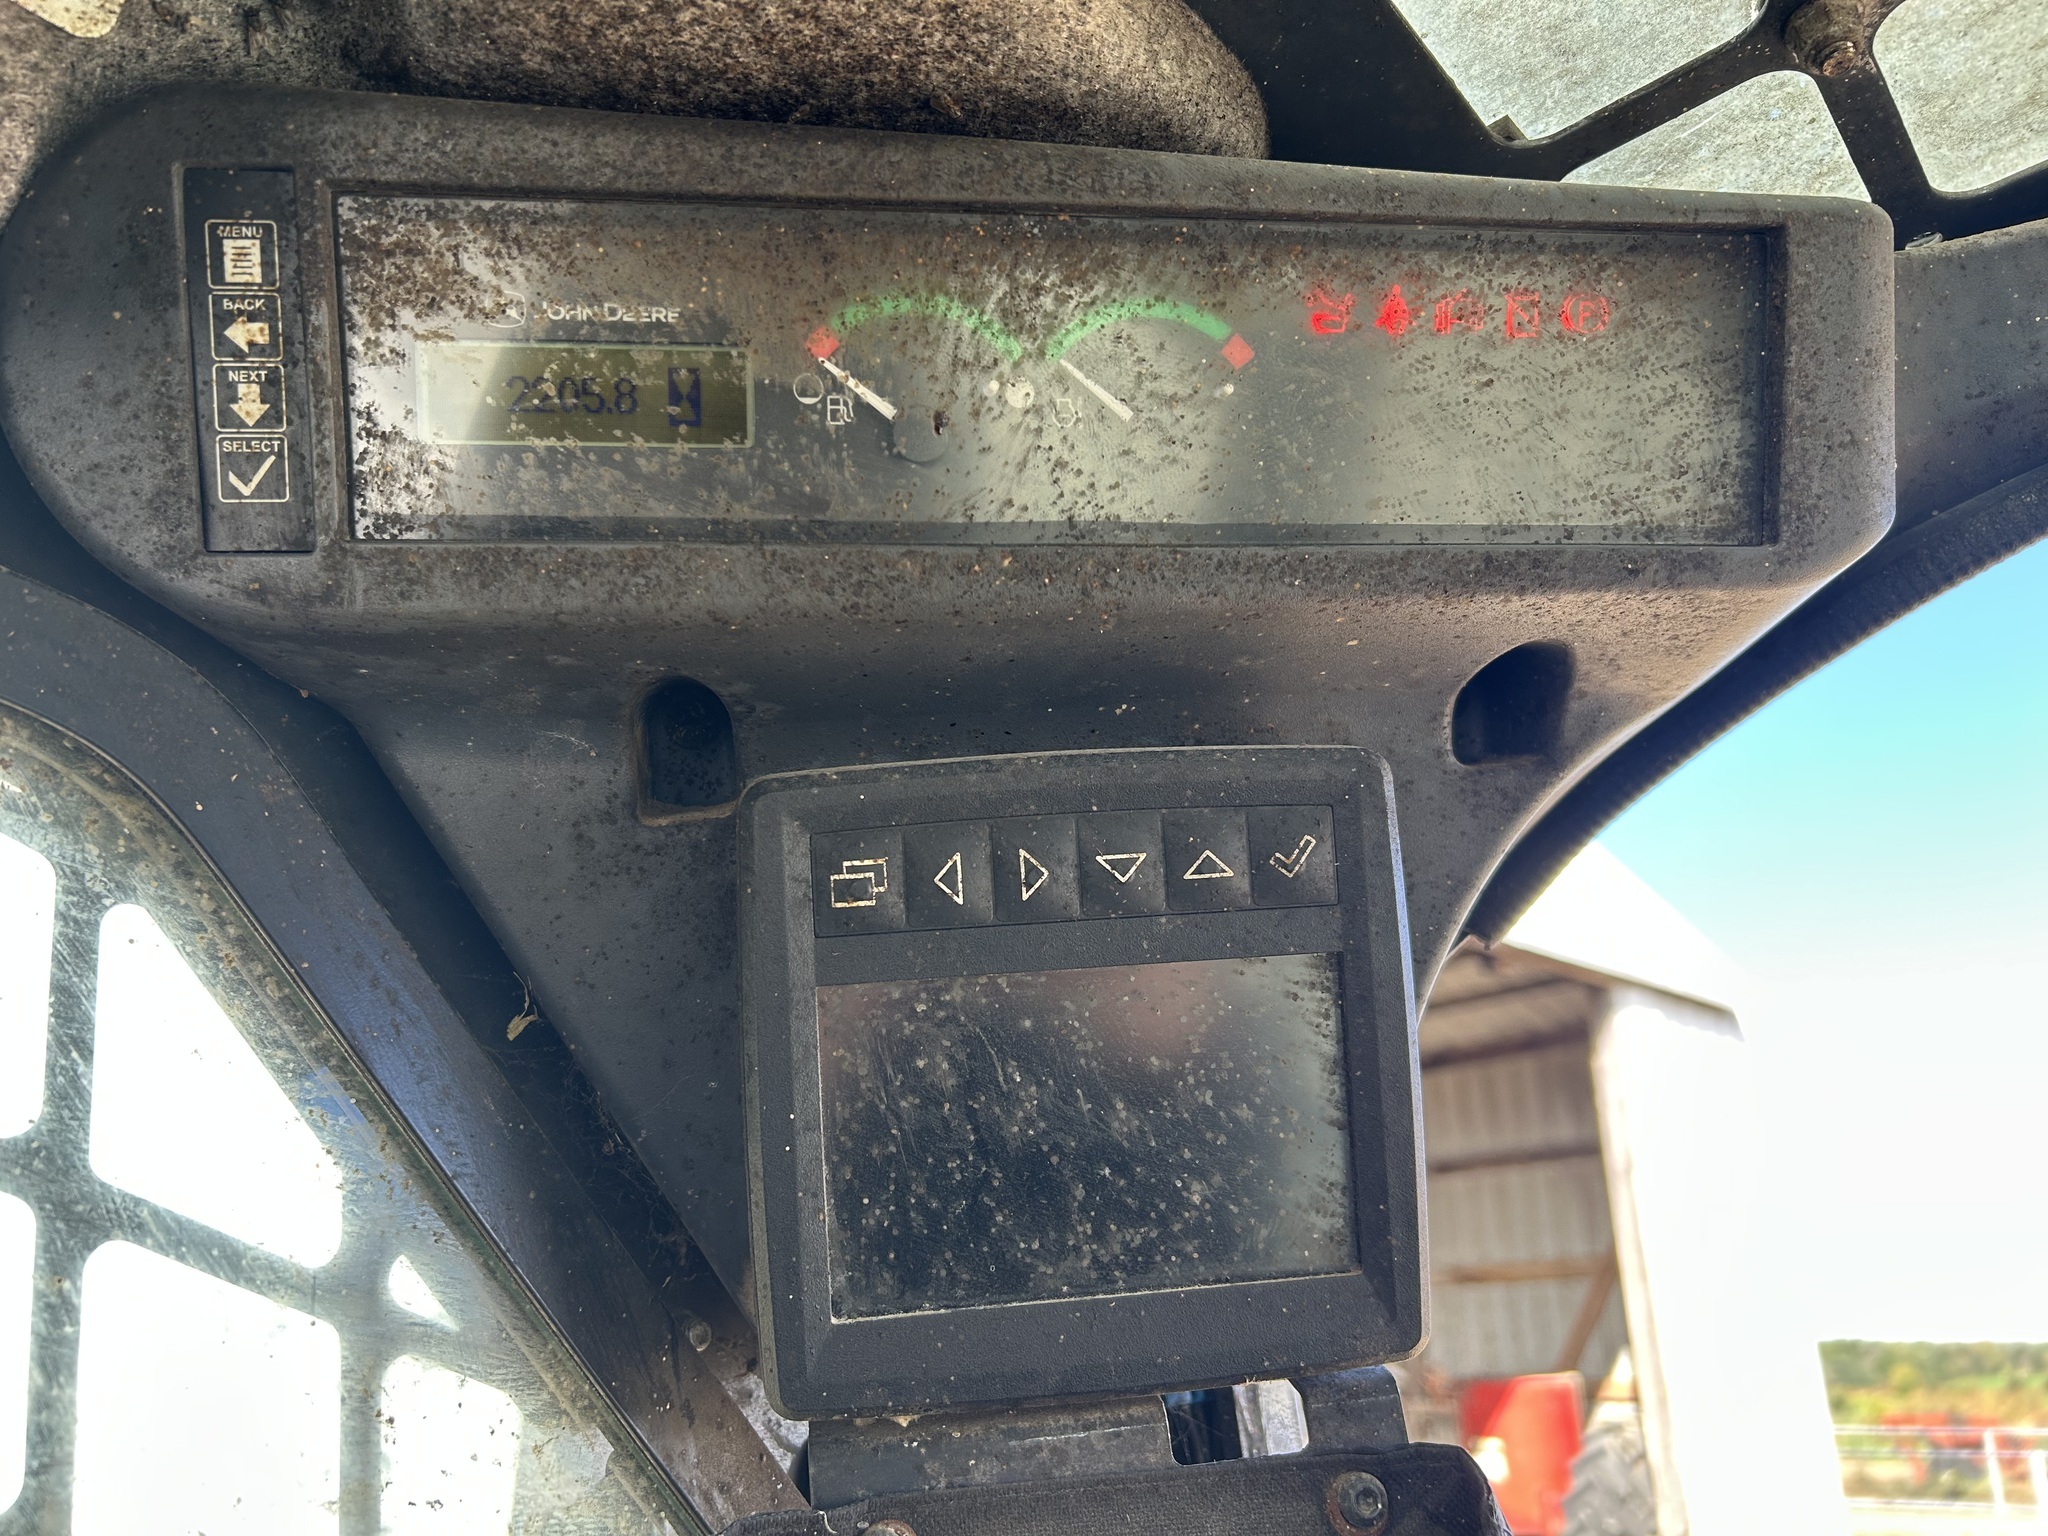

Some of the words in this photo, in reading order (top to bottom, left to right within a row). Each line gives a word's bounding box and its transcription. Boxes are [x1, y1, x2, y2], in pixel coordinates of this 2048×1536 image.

[218, 226, 262, 238] MENU
[222, 298, 266, 311] BACK
[534, 300, 600, 323] JOHN
[603, 302, 681, 323] DEERE
[228, 370, 268, 382] NEXT
[506, 376, 638, 414] 2205.8
[222, 440, 281, 452] SELECT
